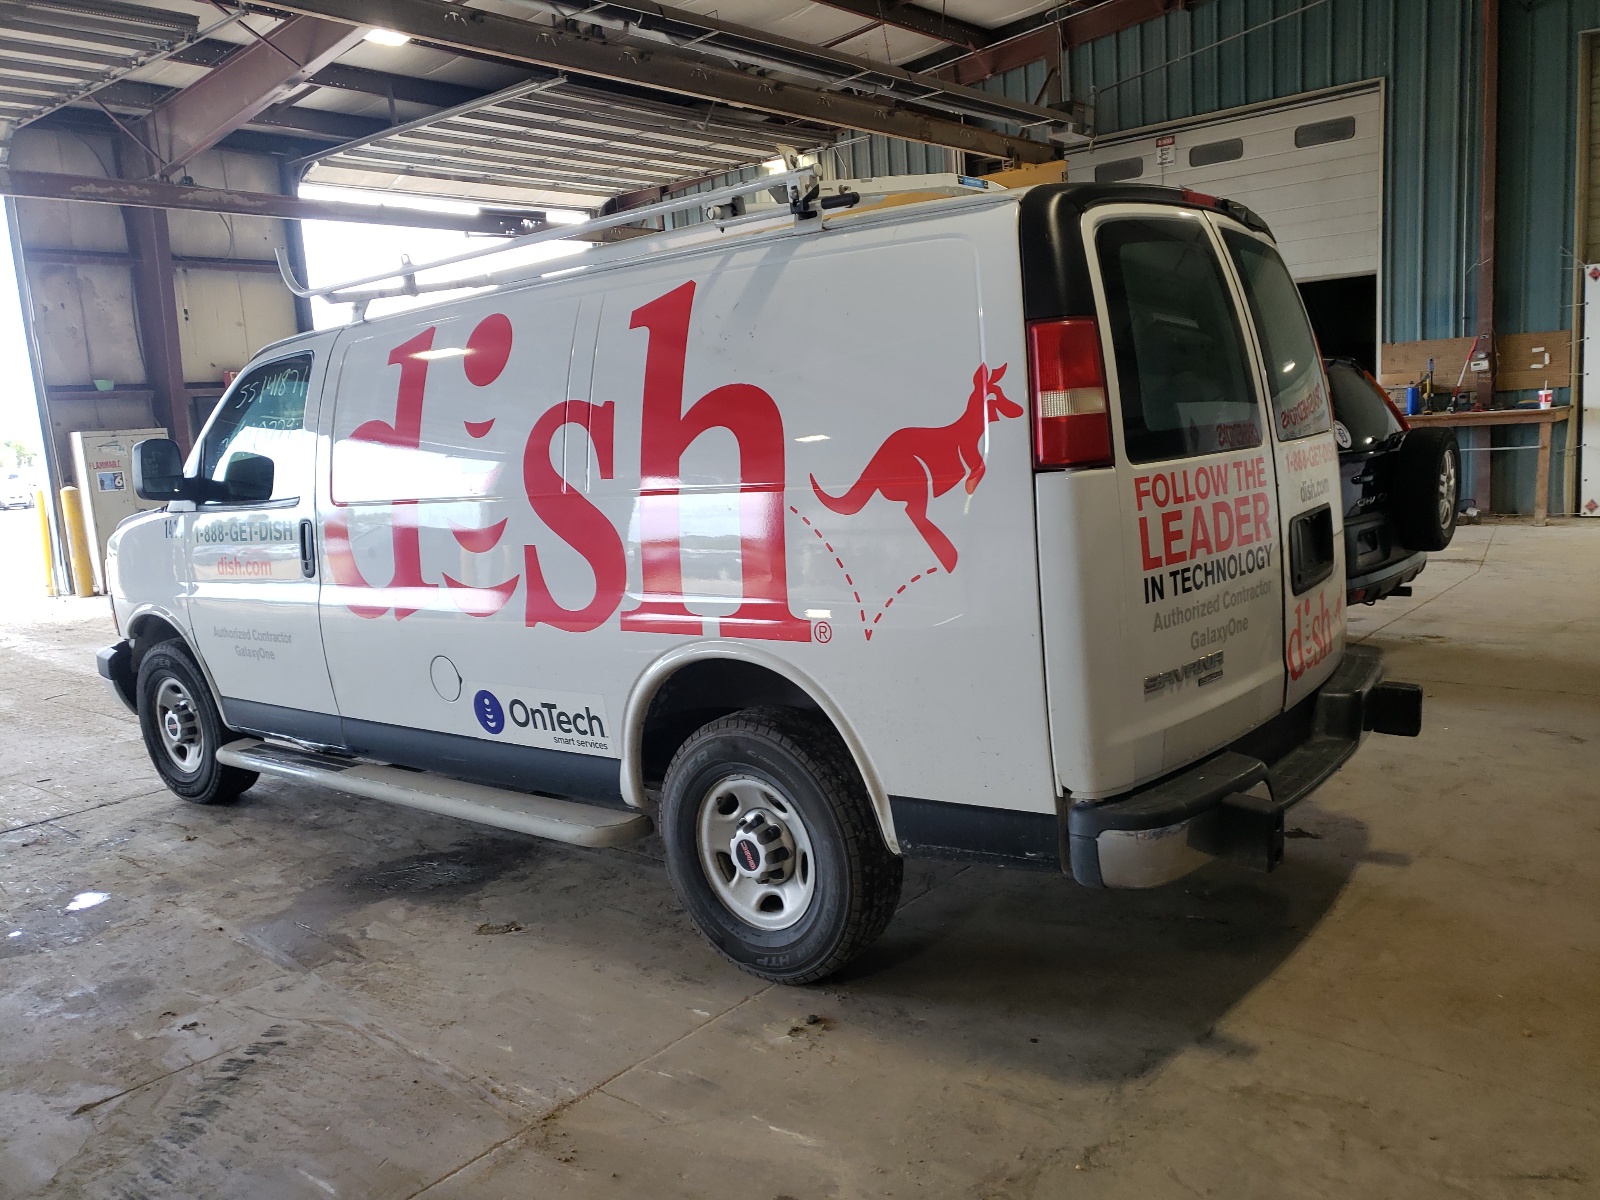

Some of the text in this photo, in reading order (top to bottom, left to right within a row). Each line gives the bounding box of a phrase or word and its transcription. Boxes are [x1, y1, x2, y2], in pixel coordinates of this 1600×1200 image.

[89, 460, 121, 469] FLAMMABLE
[324, 280, 811, 642] dish
[1134, 456, 1267, 511] FOLLOW THE
[1301, 478, 1329, 502] dish.com
[195, 520, 293, 543] 1-888-GET-DISH
[1139, 492, 1272, 571] LEADER
[217, 556, 272, 576] dish.com
[1144, 543, 1273, 604] IN TECHNOLOGY
[1153, 580, 1272, 632] Authorized Contractor
[213, 626, 292, 644] Authorized Contractor
[1190, 617, 1249, 650] GalaxyOne
[1287, 590, 1333, 681] dish
[234, 645, 275, 660] GalaxyOne
[508, 698, 605, 738] OnTech
[553, 736, 608, 750] smart services
